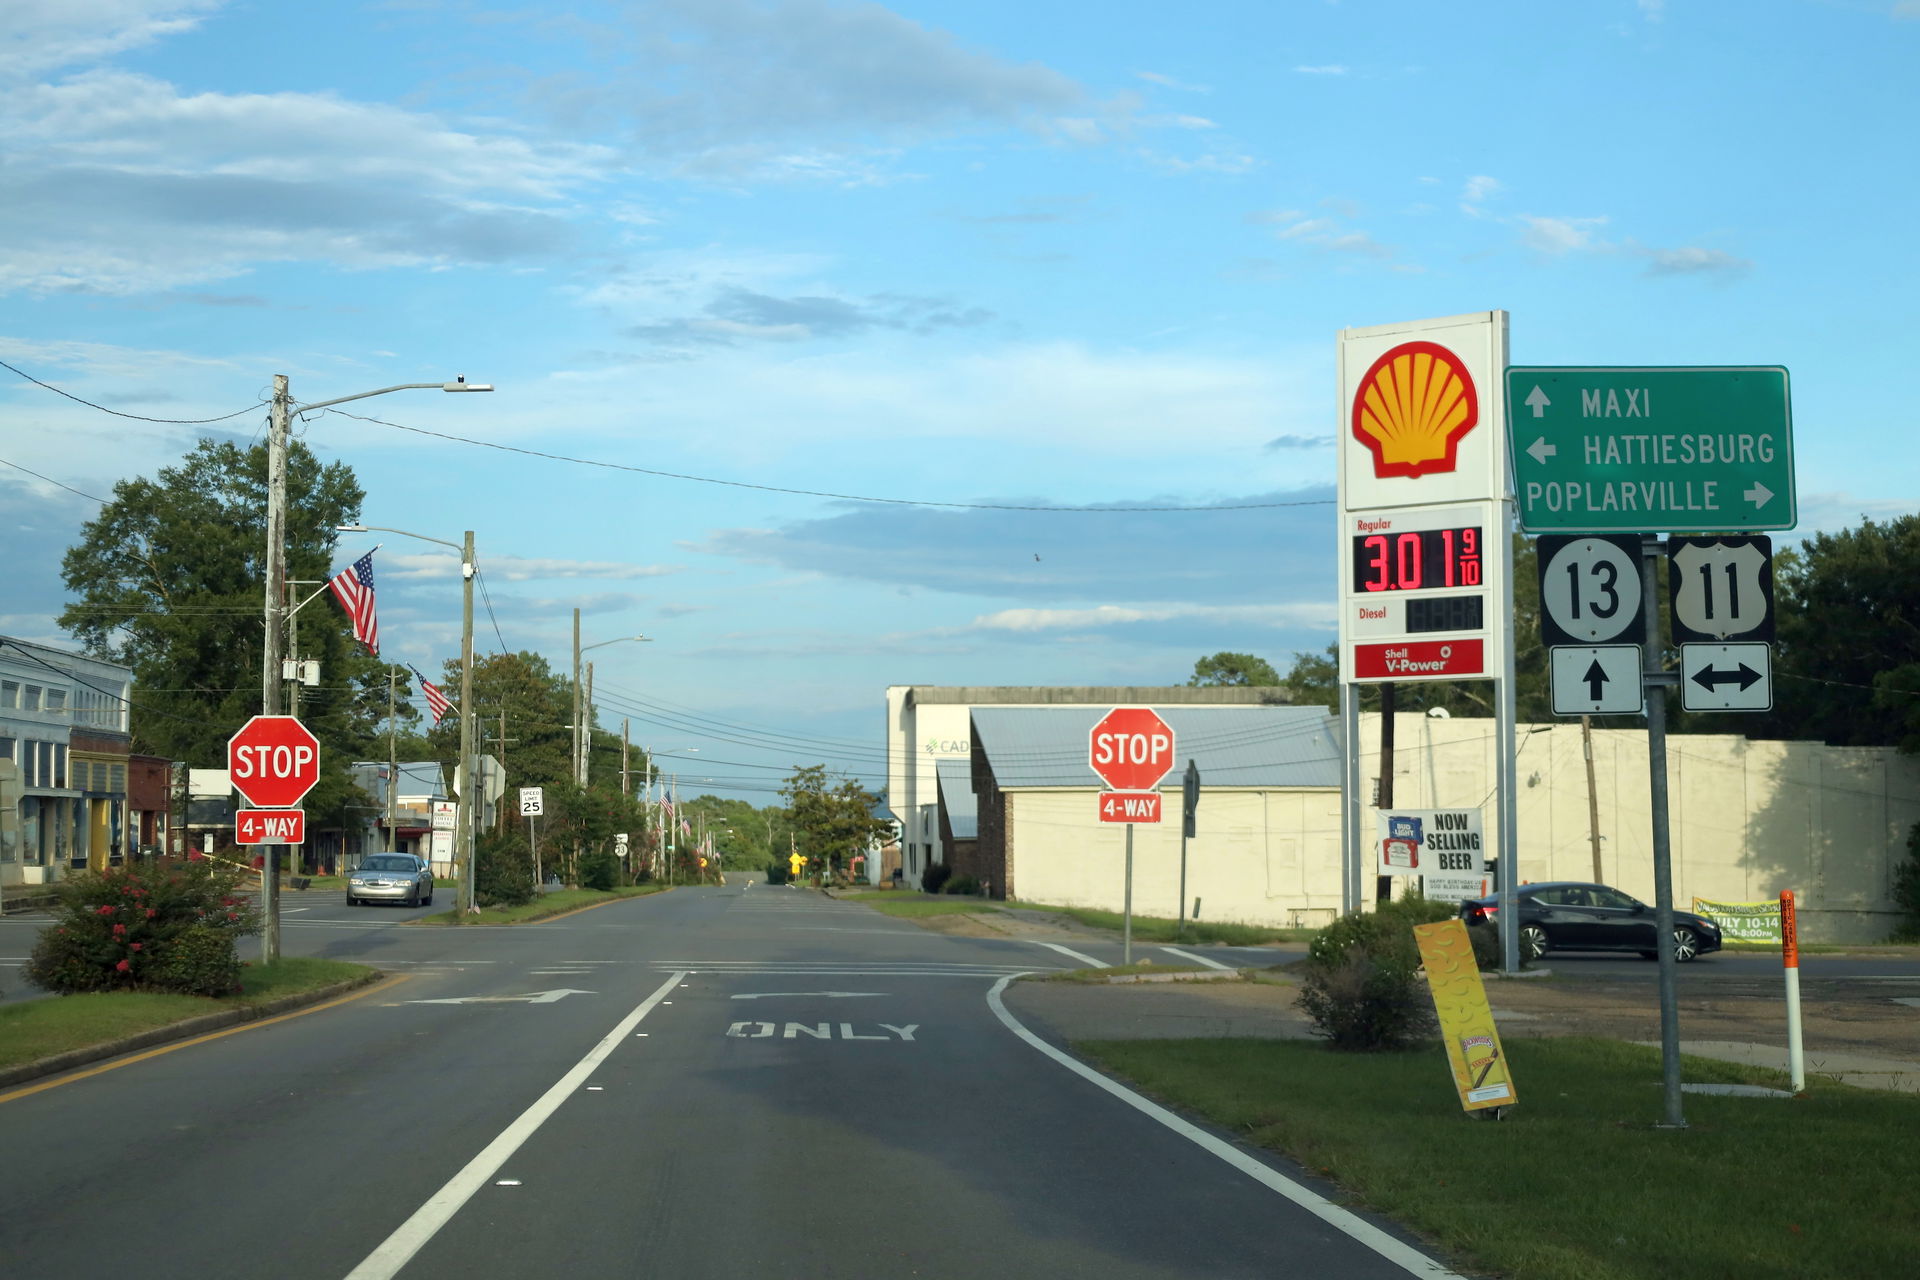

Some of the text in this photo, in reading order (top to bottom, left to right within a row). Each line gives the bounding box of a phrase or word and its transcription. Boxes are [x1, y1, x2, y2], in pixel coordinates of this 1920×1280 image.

[1582, 388, 1650, 418] MAXI
[1584, 433, 1774, 465] HATTIESBURG
[1527, 481, 1720, 512] POPLARVILLE
[1357, 518, 1391, 533] Regular
[1566, 560, 1619, 620] 13
[1699, 562, 1739, 620] 11
[1359, 607, 1386, 624] Diesel
[1385, 649, 1408, 659] Shell
[1386, 659, 1446, 677] V-Power
[1096, 733, 1169, 765] STOP
[235, 745, 313, 778] STOP
[523, 801, 540, 812] 25
[1103, 799, 1156, 817] 4-WAY
[242, 818, 298, 837] 4-WAY
[1434, 813, 1467, 830] NOW
[1426, 833, 1480, 850] SELLING
[1438, 853, 1472, 870] BEER
[1745, 917, 1779, 928] 10-14
[726, 1022, 920, 1041] ONLY
